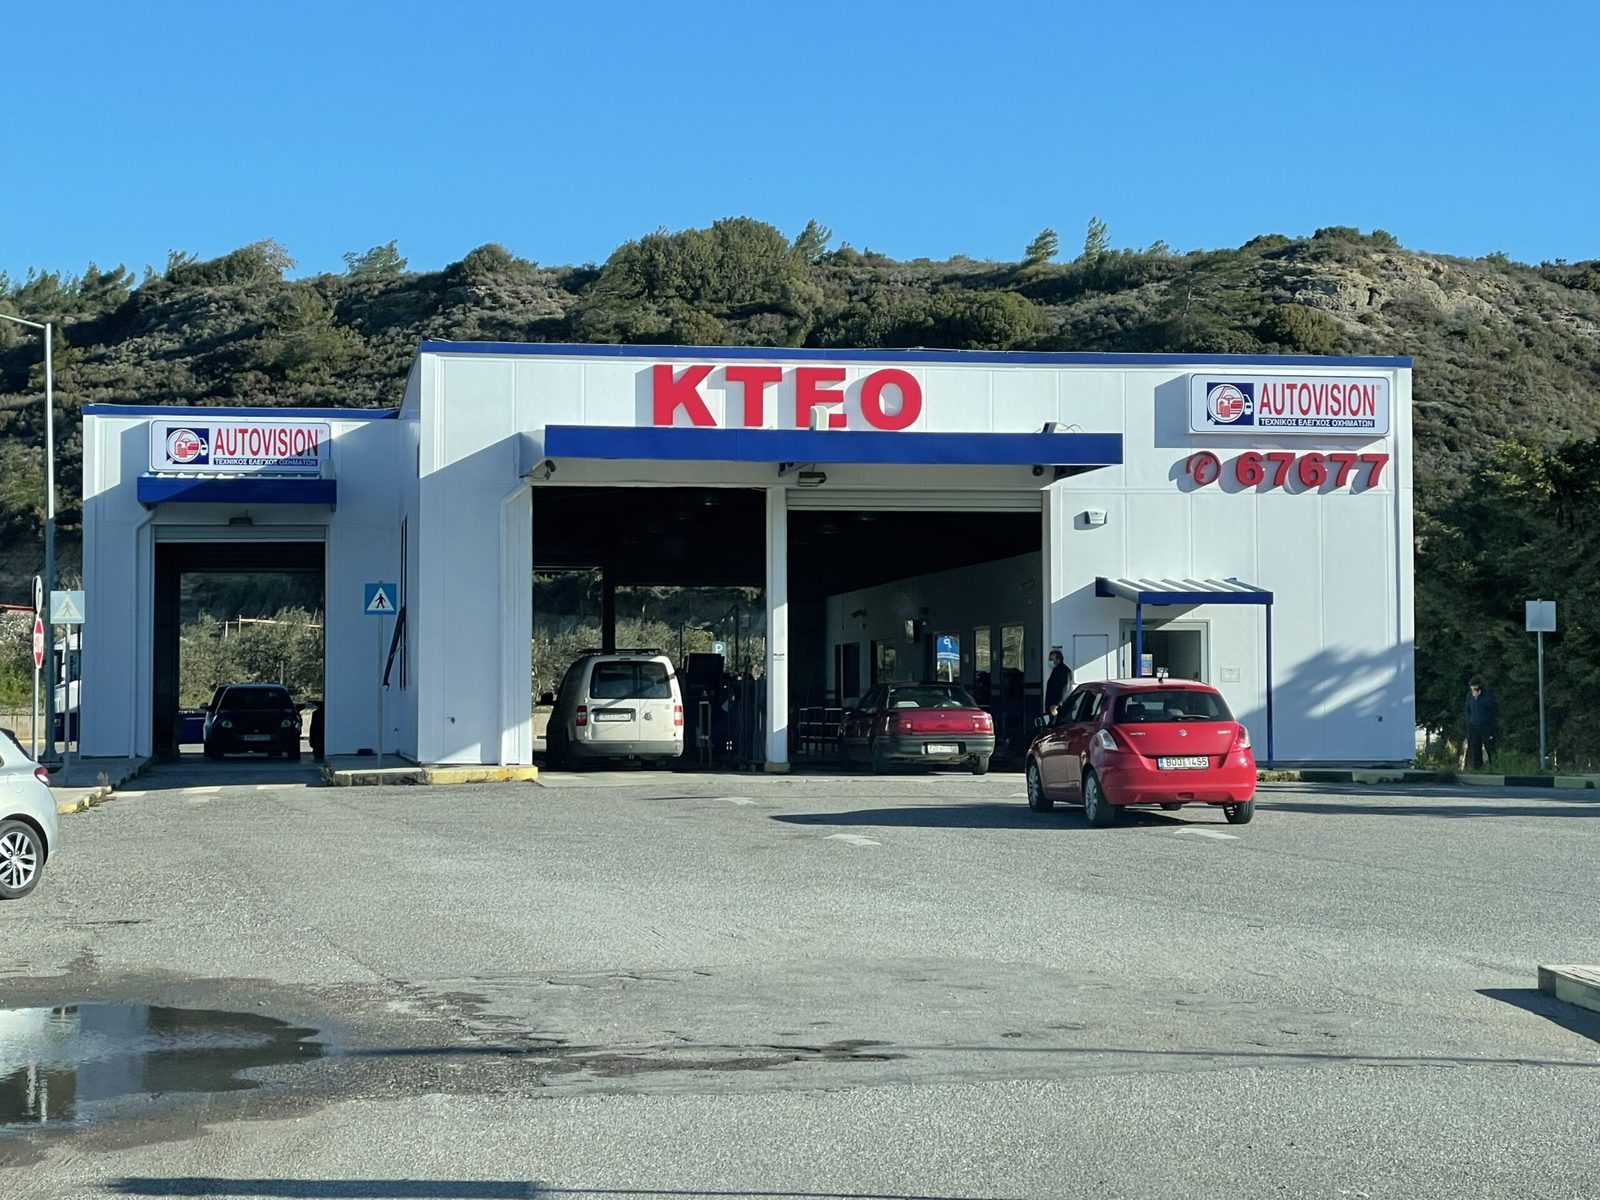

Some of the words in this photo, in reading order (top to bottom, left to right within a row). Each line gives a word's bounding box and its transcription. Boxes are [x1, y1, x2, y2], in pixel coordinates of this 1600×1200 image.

[1259, 382, 1375, 417] AUTOVISION
[1260, 418, 1297, 426] ΤΕΧΝΙΚΟΣ
[1298, 419, 1331, 427] ΕΛΕΓΧΟΣ
[1331, 419, 1373, 427] ΟΧΗΜΑΤΩΝ
[213, 428, 318, 457] AUTOVISION
[1235, 451, 1389, 488] 67677
